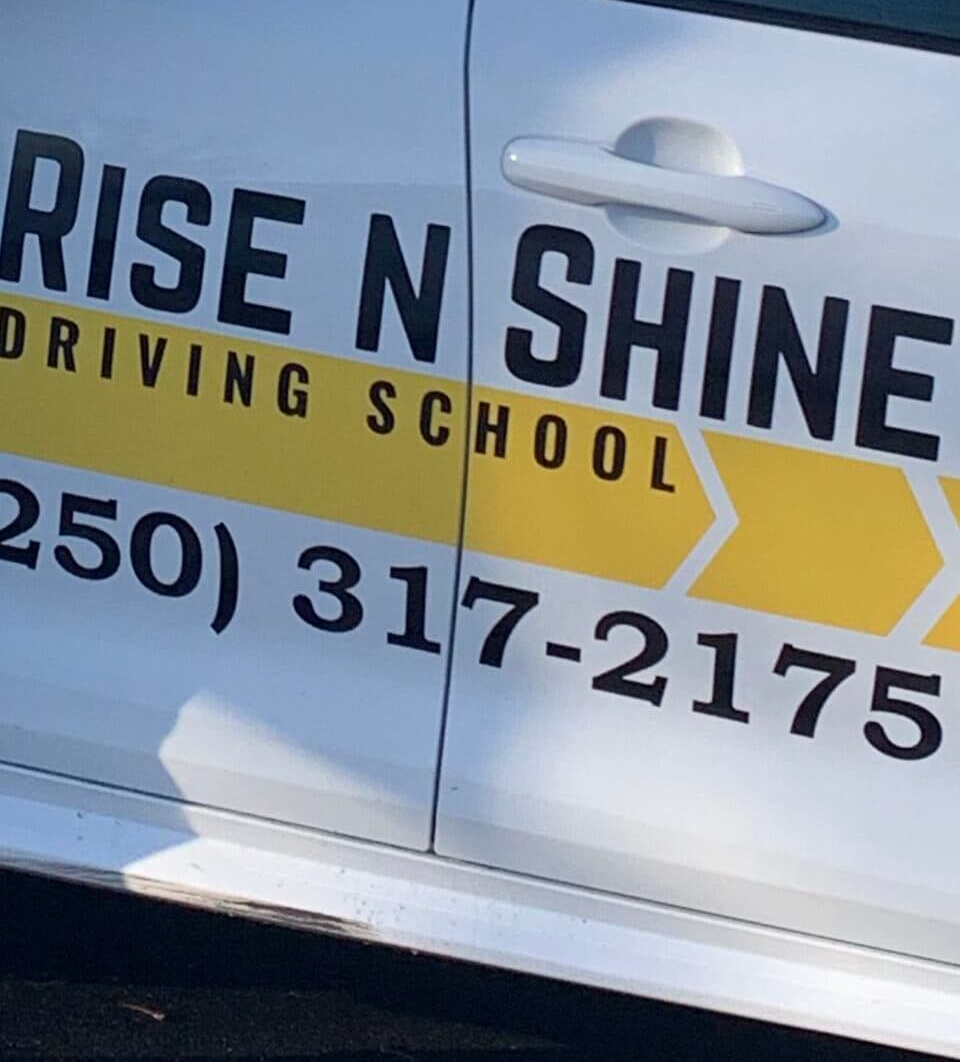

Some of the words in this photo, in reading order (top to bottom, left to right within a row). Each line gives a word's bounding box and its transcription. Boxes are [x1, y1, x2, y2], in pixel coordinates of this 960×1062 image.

[355, 213, 451, 364] N
[505, 224, 955, 462] SHINE
[366, 380, 677, 493] SCHOOL
[292, 545, 944, 761] 317-2175
